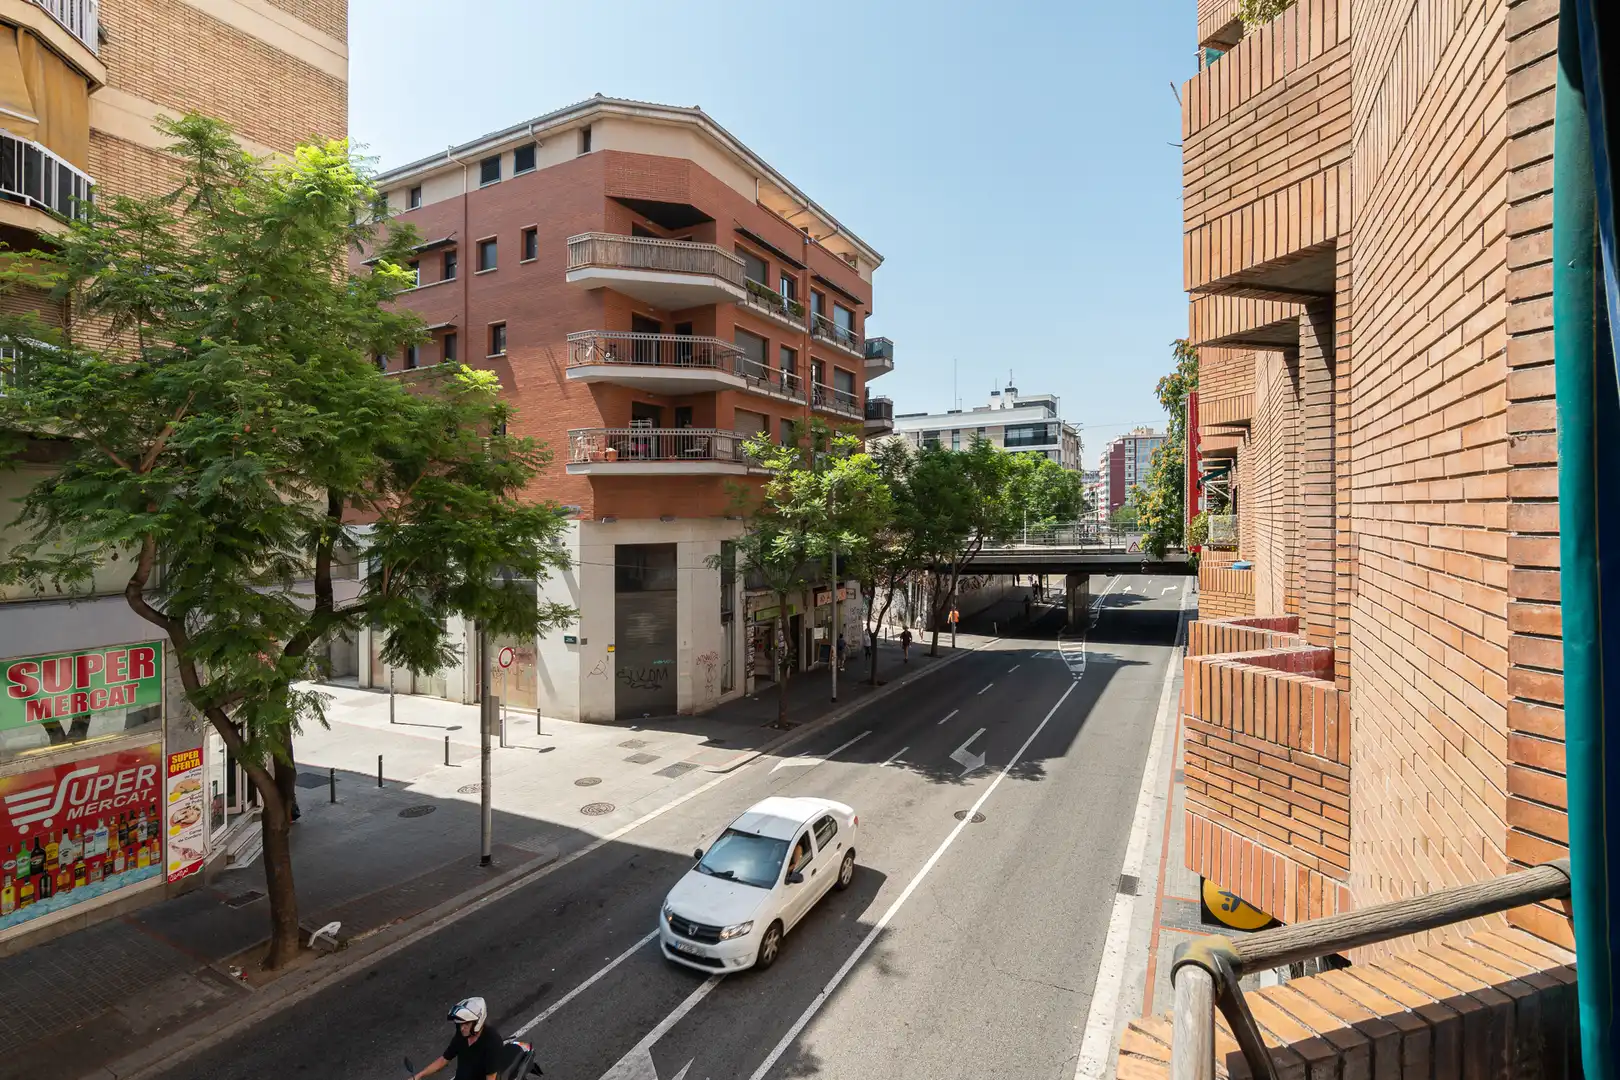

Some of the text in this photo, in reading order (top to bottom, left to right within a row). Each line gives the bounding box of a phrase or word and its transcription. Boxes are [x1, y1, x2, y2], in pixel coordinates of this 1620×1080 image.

[7, 647, 155, 699] SUPER
[25, 682, 140, 723] MERCAT
[170, 758, 201, 773] OFERTA
[171, 750, 199, 764] SUPER
[44, 764, 156, 818] SUPER
[66, 788, 152, 821] MERCAT
